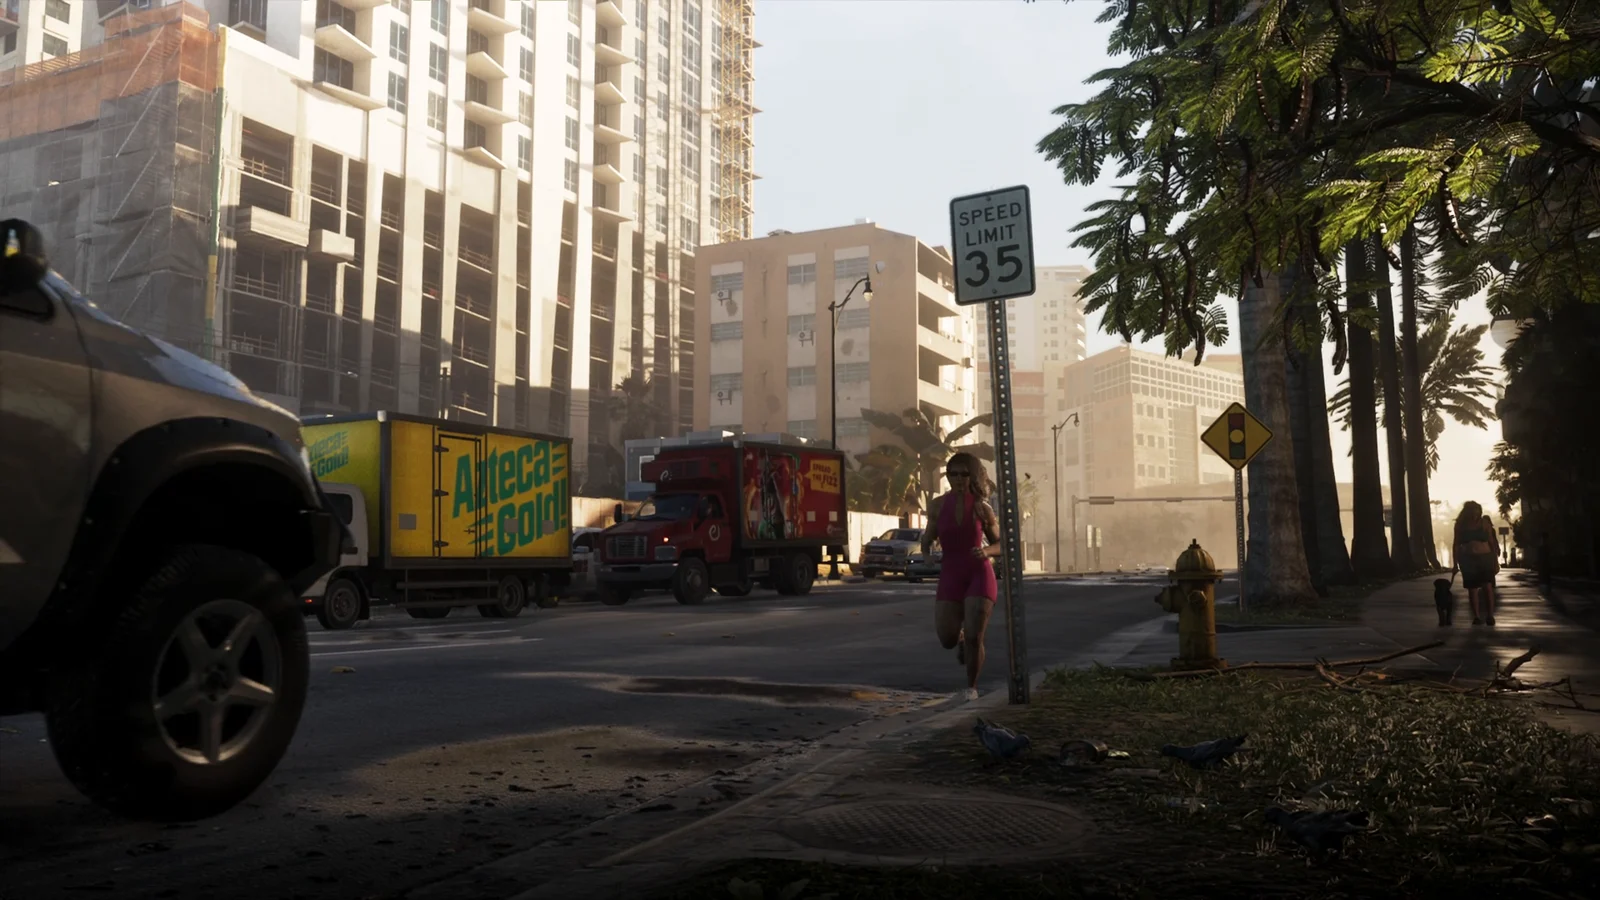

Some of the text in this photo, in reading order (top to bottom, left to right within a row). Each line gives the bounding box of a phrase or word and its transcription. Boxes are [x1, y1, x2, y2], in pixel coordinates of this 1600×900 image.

[959, 202, 1022, 227] SPEED
[966, 224, 1016, 247] LIMIT
[965, 244, 1023, 288] 35
[453, 440, 551, 519] Azteca
[821, 472, 838, 488] FIZZ
[497, 477, 567, 556] Gold!
